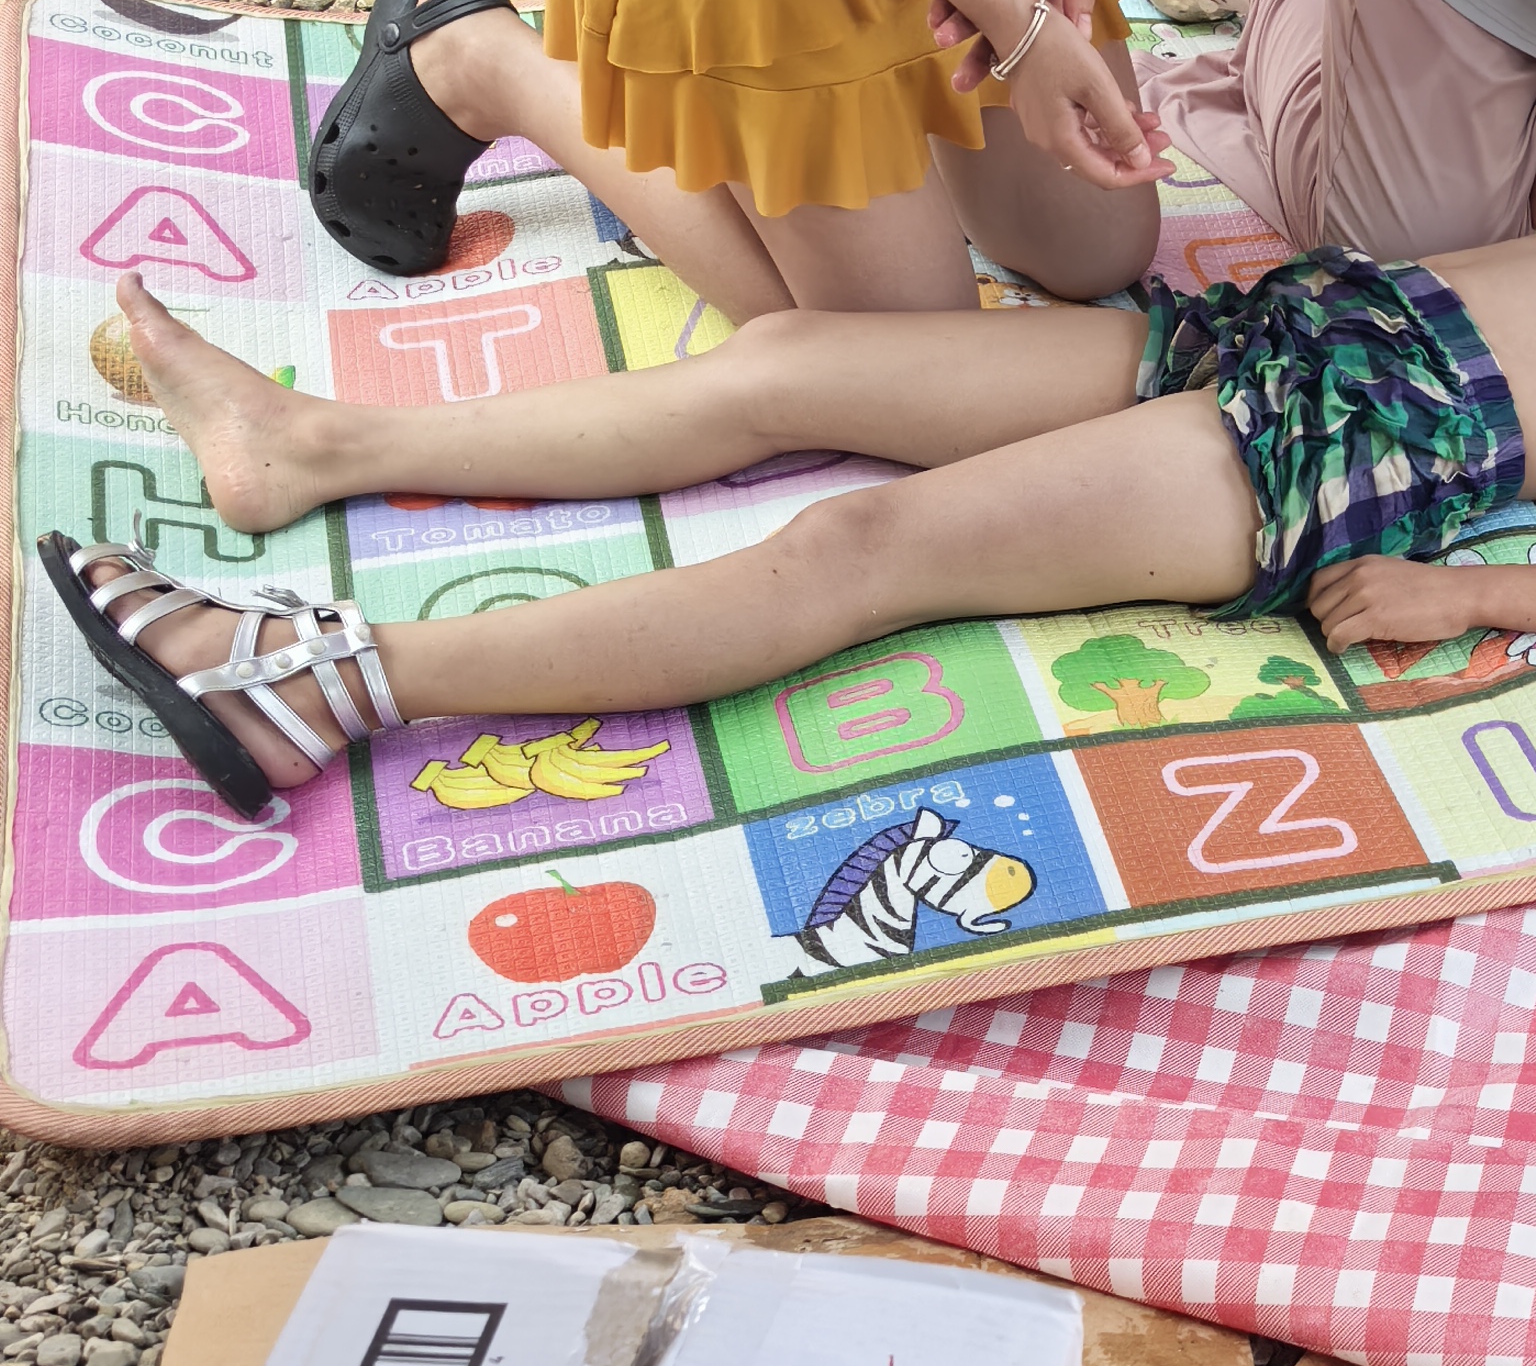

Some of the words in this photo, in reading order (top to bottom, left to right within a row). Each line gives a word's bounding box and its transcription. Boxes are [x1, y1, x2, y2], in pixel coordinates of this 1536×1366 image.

[49, 10, 275, 69] Coconut
[83, 71, 250, 154] C
[79, 185, 258, 282] A
[347, 255, 564, 301] Apple
[378, 304, 541, 403] T
[372, 504, 611, 551] Tomato
[1138, 619, 1281, 639] Tree
[775, 650, 966, 774] B
[79, 777, 299, 895] C
[402, 804, 688, 871] Banana
[784, 780, 968, 841] zebra
[1161, 749, 1358, 874] Z
[72, 941, 311, 1070] A
[432, 961, 728, 1039] Apple
